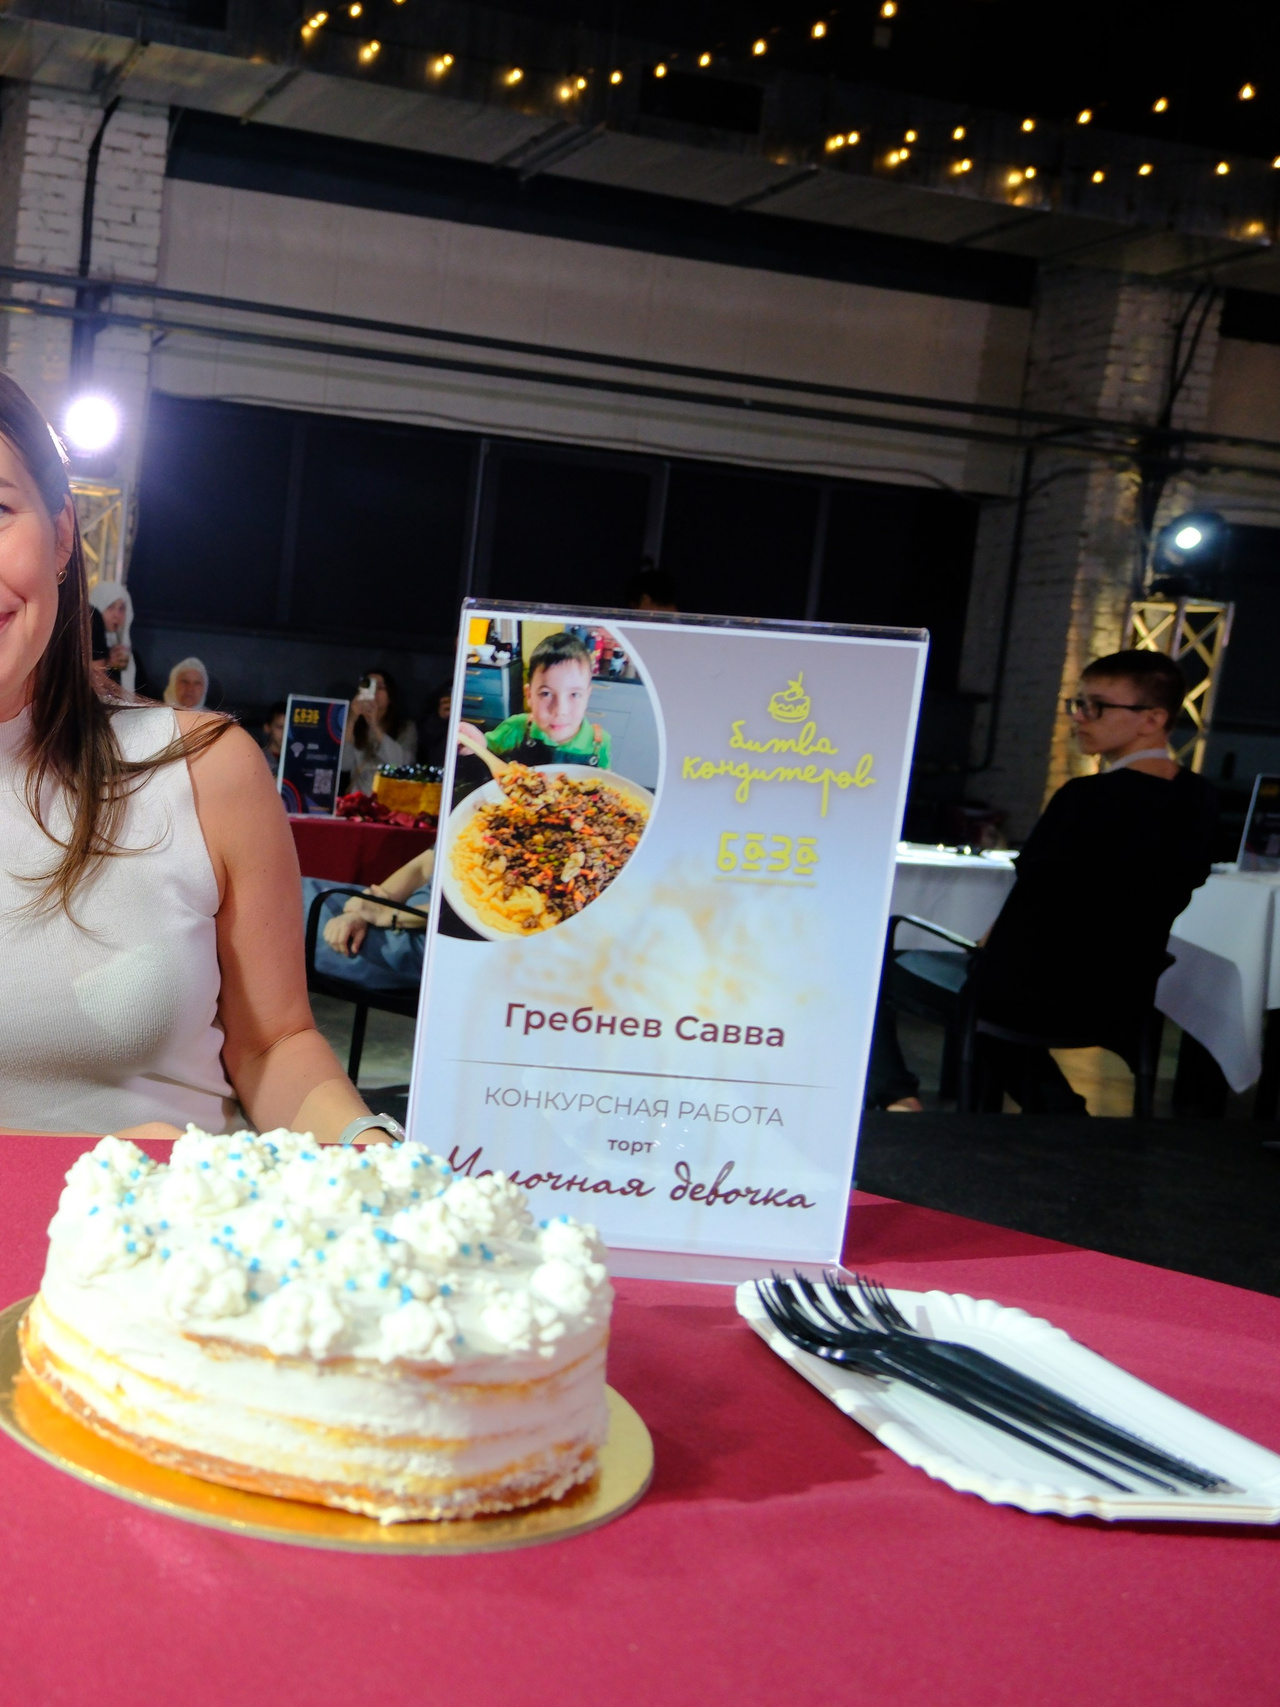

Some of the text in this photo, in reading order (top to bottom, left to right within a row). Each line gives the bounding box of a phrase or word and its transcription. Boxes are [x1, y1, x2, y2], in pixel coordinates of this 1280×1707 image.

[505, 1003, 786, 1048] Гребнев Савва
[484, 1086, 784, 1127] КОНКУРСНАЯ РАБОТА
[607, 1139, 656, 1156] торт
[669, 1160, 817, 1209] девочка
